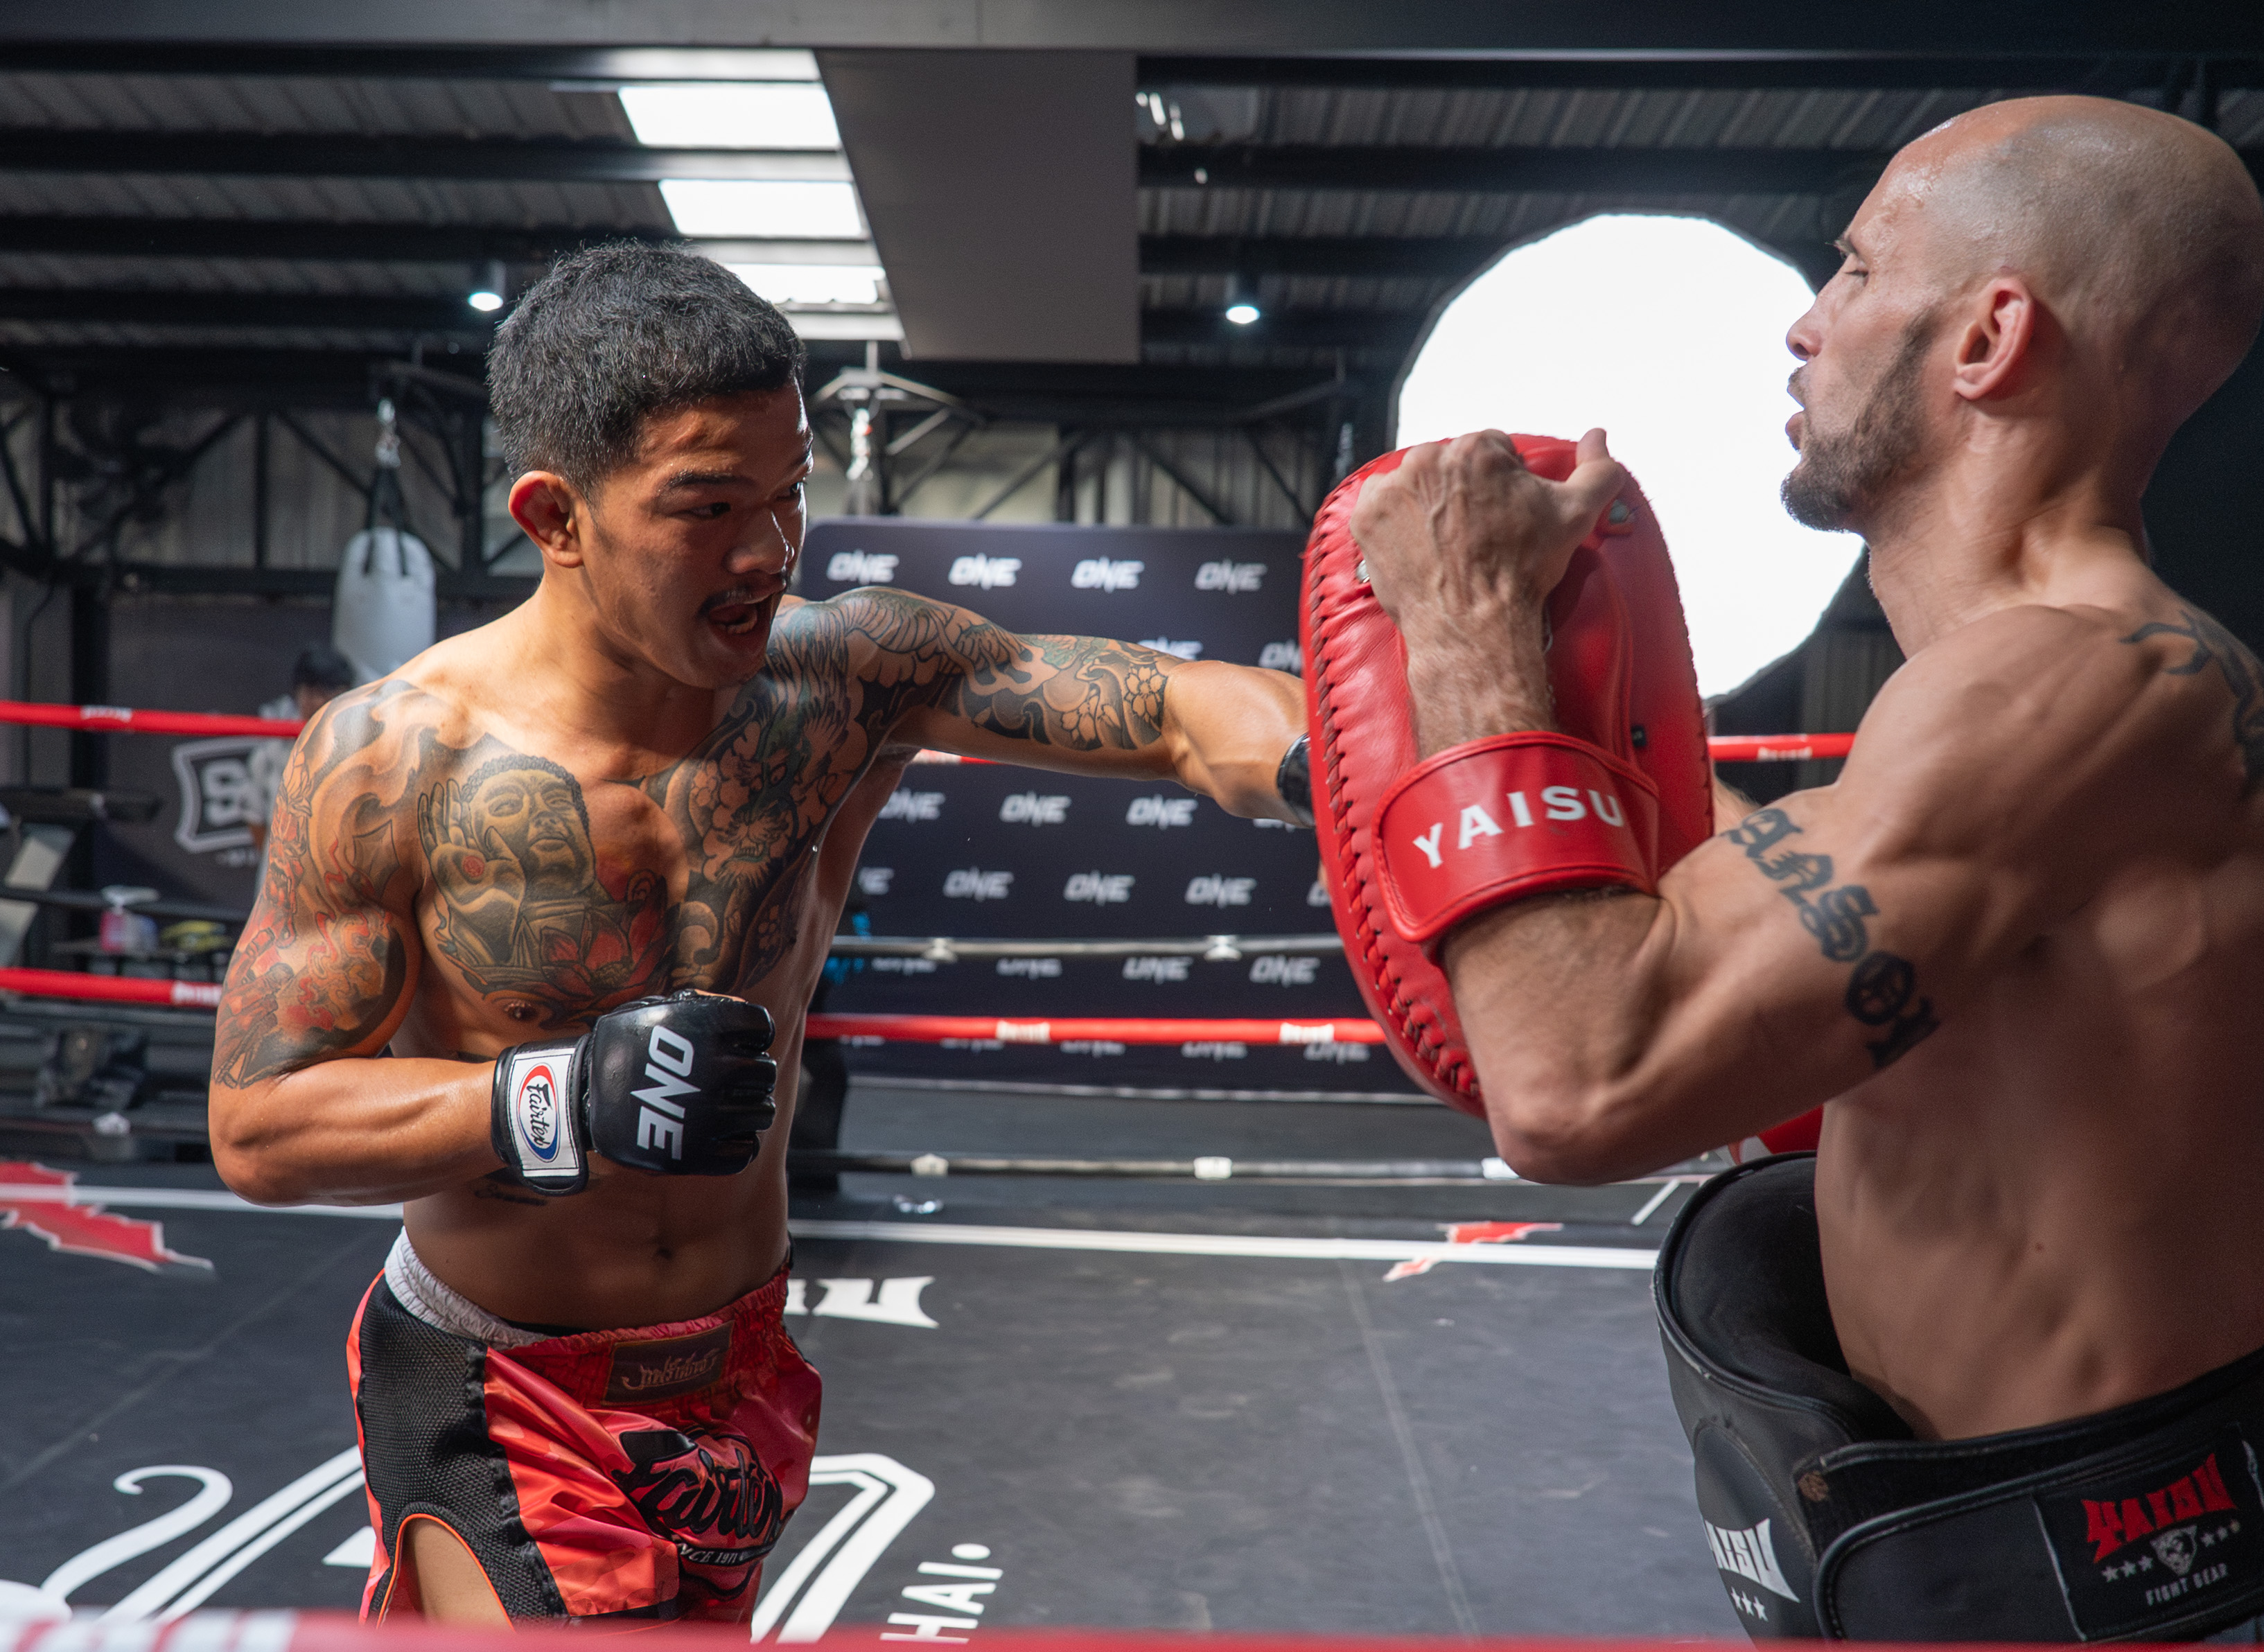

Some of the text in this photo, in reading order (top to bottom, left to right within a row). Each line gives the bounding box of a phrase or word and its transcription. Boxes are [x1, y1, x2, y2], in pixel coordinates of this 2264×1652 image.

[827, 550, 899, 586] ONE
[949, 554, 1021, 590] ONE
[1071, 557, 1143, 593] ONE
[1195, 559, 1267, 595] ONE
[999, 791, 1071, 827] ONE
[1126, 794, 1198, 829] ONE
[1413, 784, 1624, 870] YAISU
[942, 866, 1014, 902] ONE
[1063, 870, 1135, 906] ONE
[1184, 873, 1256, 908] ONE
[1249, 955, 1320, 987] ONE
[630, 1025, 701, 1161] ONE
[526, 1082, 553, 1148] Fairtex
[2081, 1452, 2237, 1563] YAISU
[1703, 1517, 1800, 1603] AISU
[2145, 1563, 2228, 1606] FIGHT GEAR
